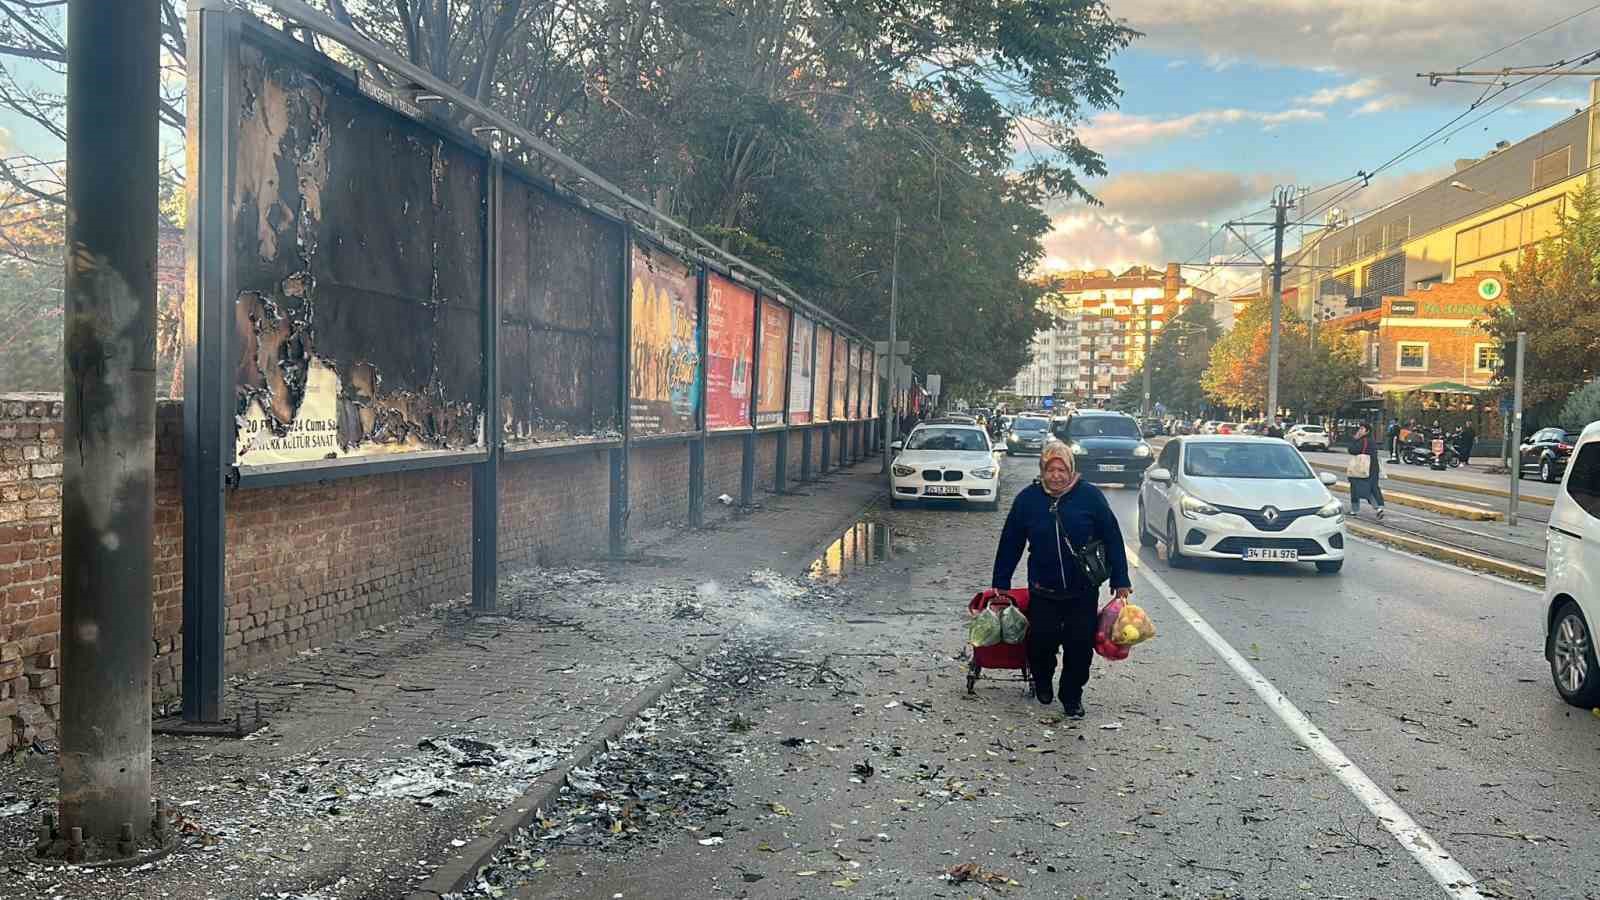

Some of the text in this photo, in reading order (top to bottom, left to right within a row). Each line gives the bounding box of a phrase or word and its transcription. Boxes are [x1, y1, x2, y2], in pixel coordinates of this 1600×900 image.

[305, 418, 326, 432] Cuma
[312, 434, 336, 448] SANAT
[1248, 549, 1258, 558] 34
[1280, 549, 1296, 559] 976
